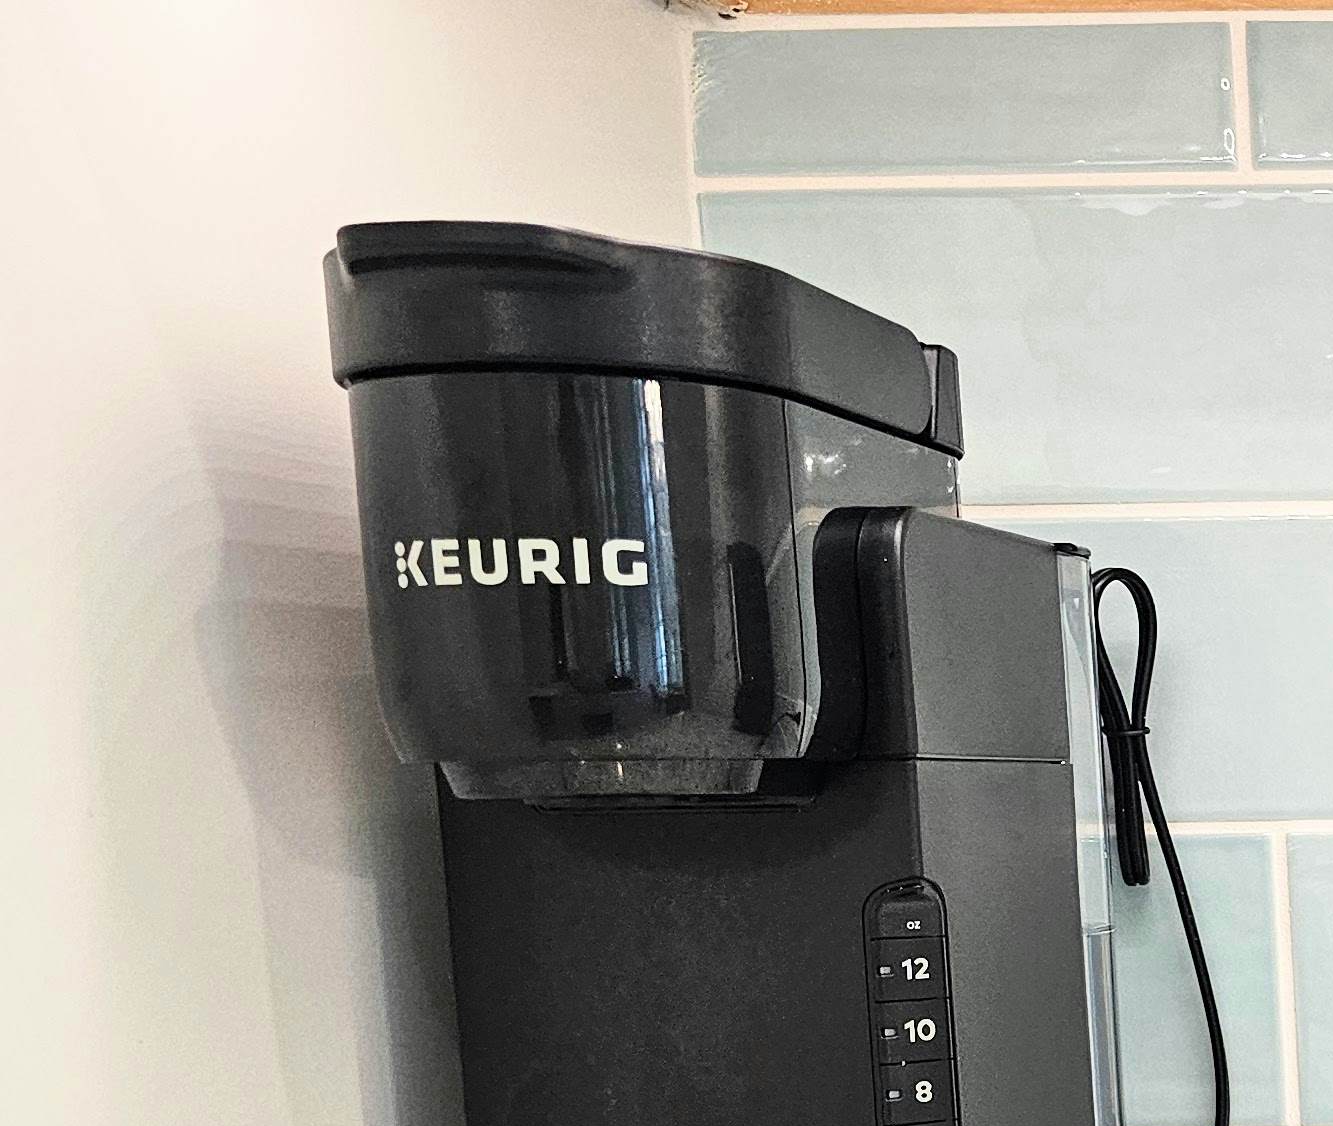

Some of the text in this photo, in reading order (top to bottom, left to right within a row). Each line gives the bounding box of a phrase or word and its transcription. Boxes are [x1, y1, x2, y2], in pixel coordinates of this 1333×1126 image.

[394, 537, 649, 589] KEURIG
[901, 957, 930, 981] 12
[903, 1018, 936, 1043] 10
[915, 1080, 933, 1103] 8
